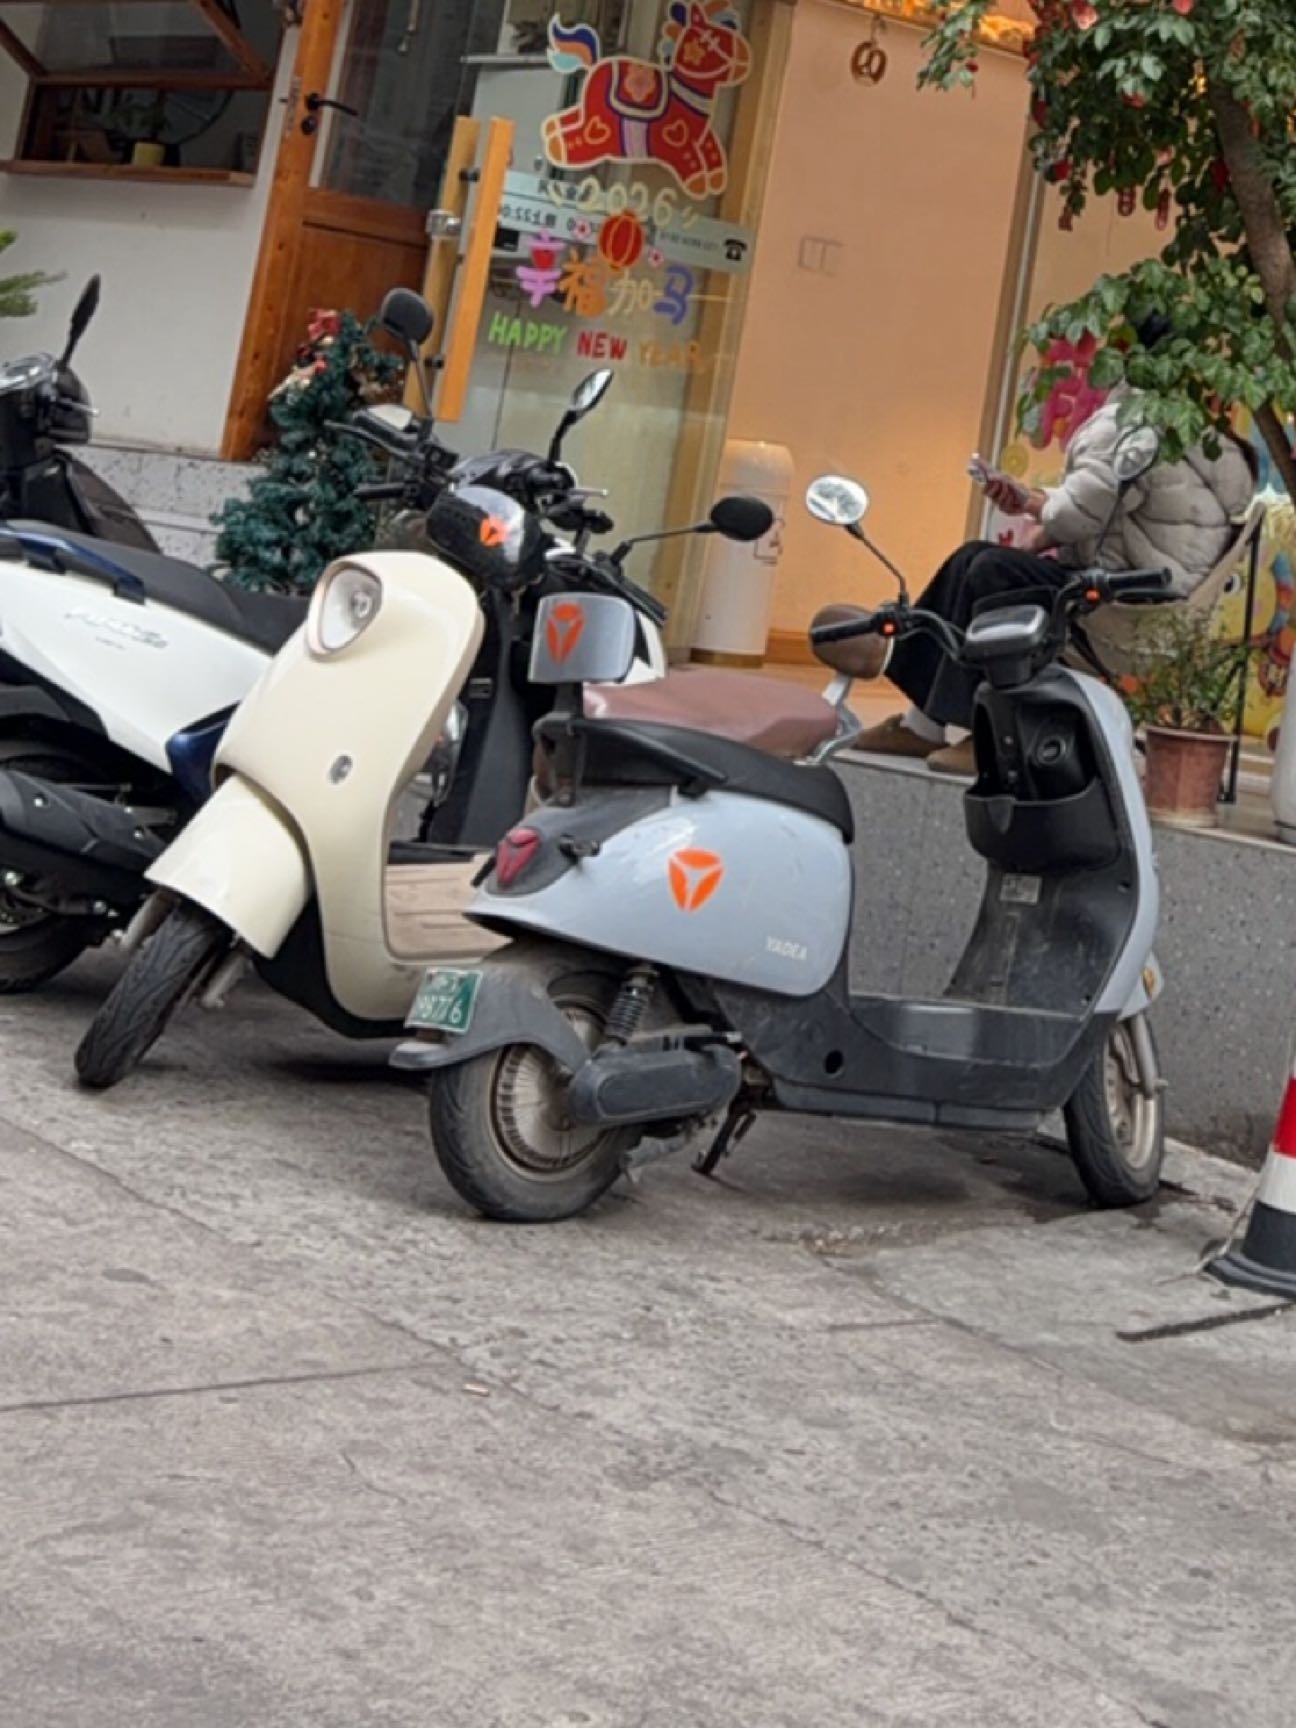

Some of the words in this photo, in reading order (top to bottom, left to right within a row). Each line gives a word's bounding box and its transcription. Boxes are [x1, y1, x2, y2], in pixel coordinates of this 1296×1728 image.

[576, 176, 679, 227] 2026
[488, 311, 567, 353] HAPPY
[577, 330, 628, 361] NEW
